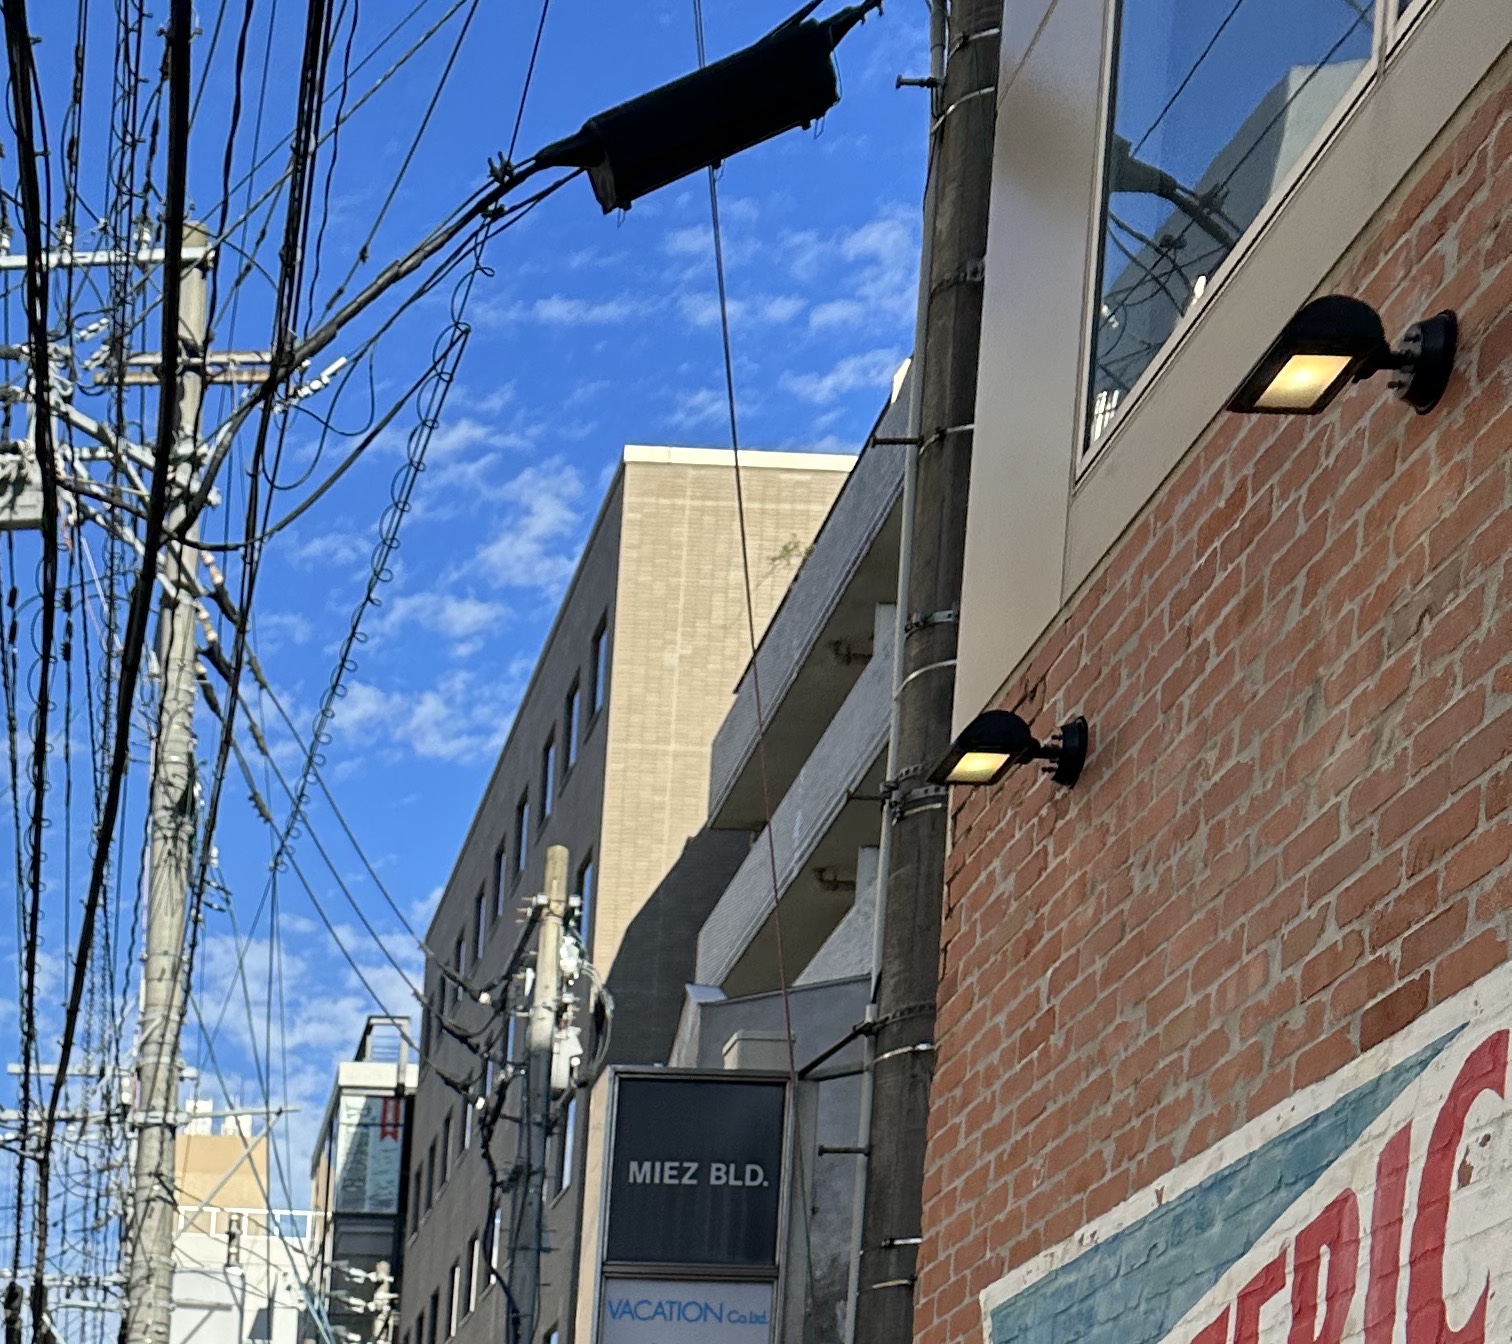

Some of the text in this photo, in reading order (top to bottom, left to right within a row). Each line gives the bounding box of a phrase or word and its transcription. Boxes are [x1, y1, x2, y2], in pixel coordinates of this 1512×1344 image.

[628, 1160, 769, 1188] MIEZ BLD.
[607, 1299, 724, 1324] VACATION
